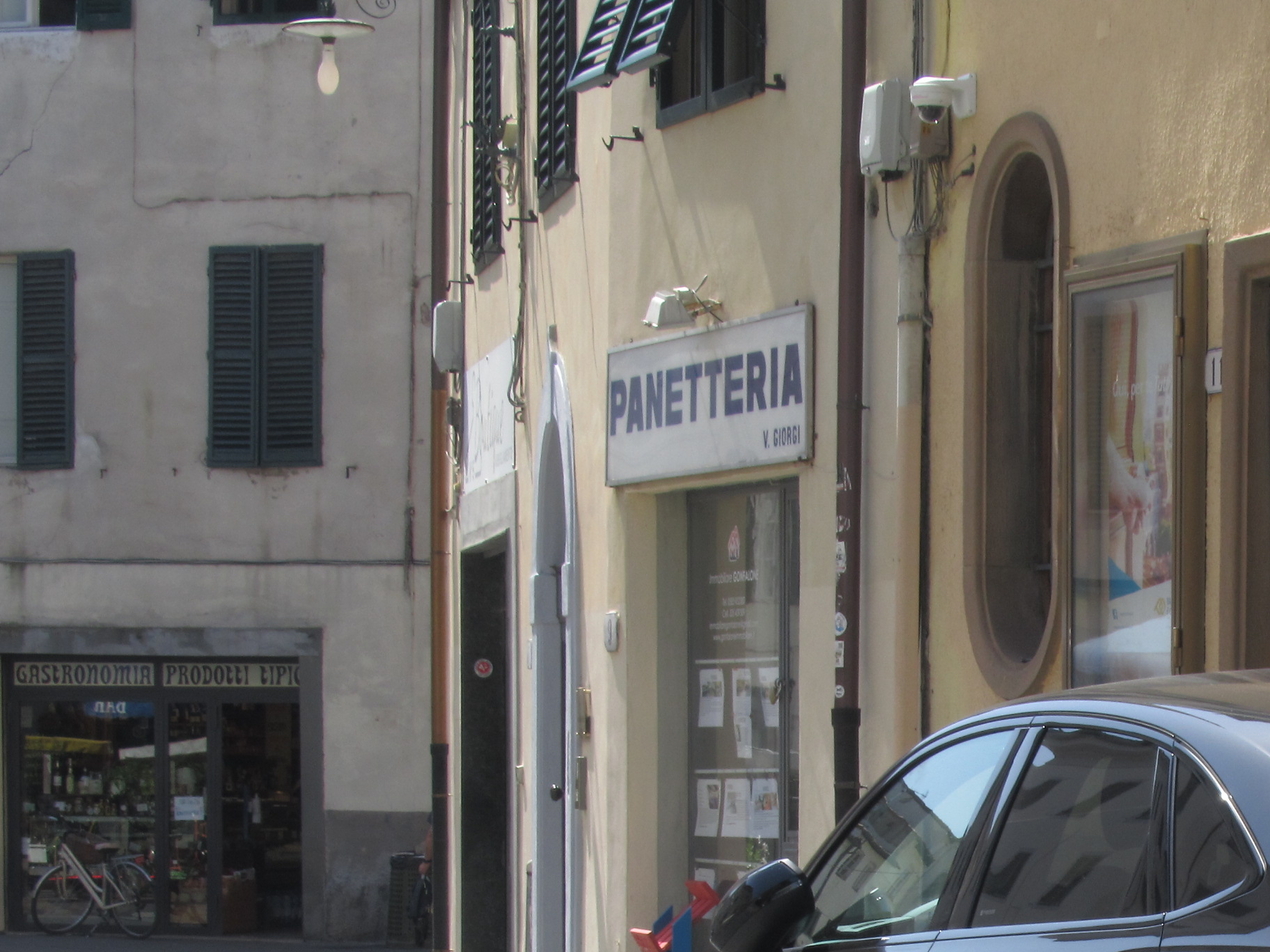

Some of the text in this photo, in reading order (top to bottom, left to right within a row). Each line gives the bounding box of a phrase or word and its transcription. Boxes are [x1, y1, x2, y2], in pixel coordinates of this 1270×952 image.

[610, 343, 803, 436] PANETTERIA
[763, 425, 800, 448] V. GIORGI
[16, 664, 152, 685] GASTRONOMIA
